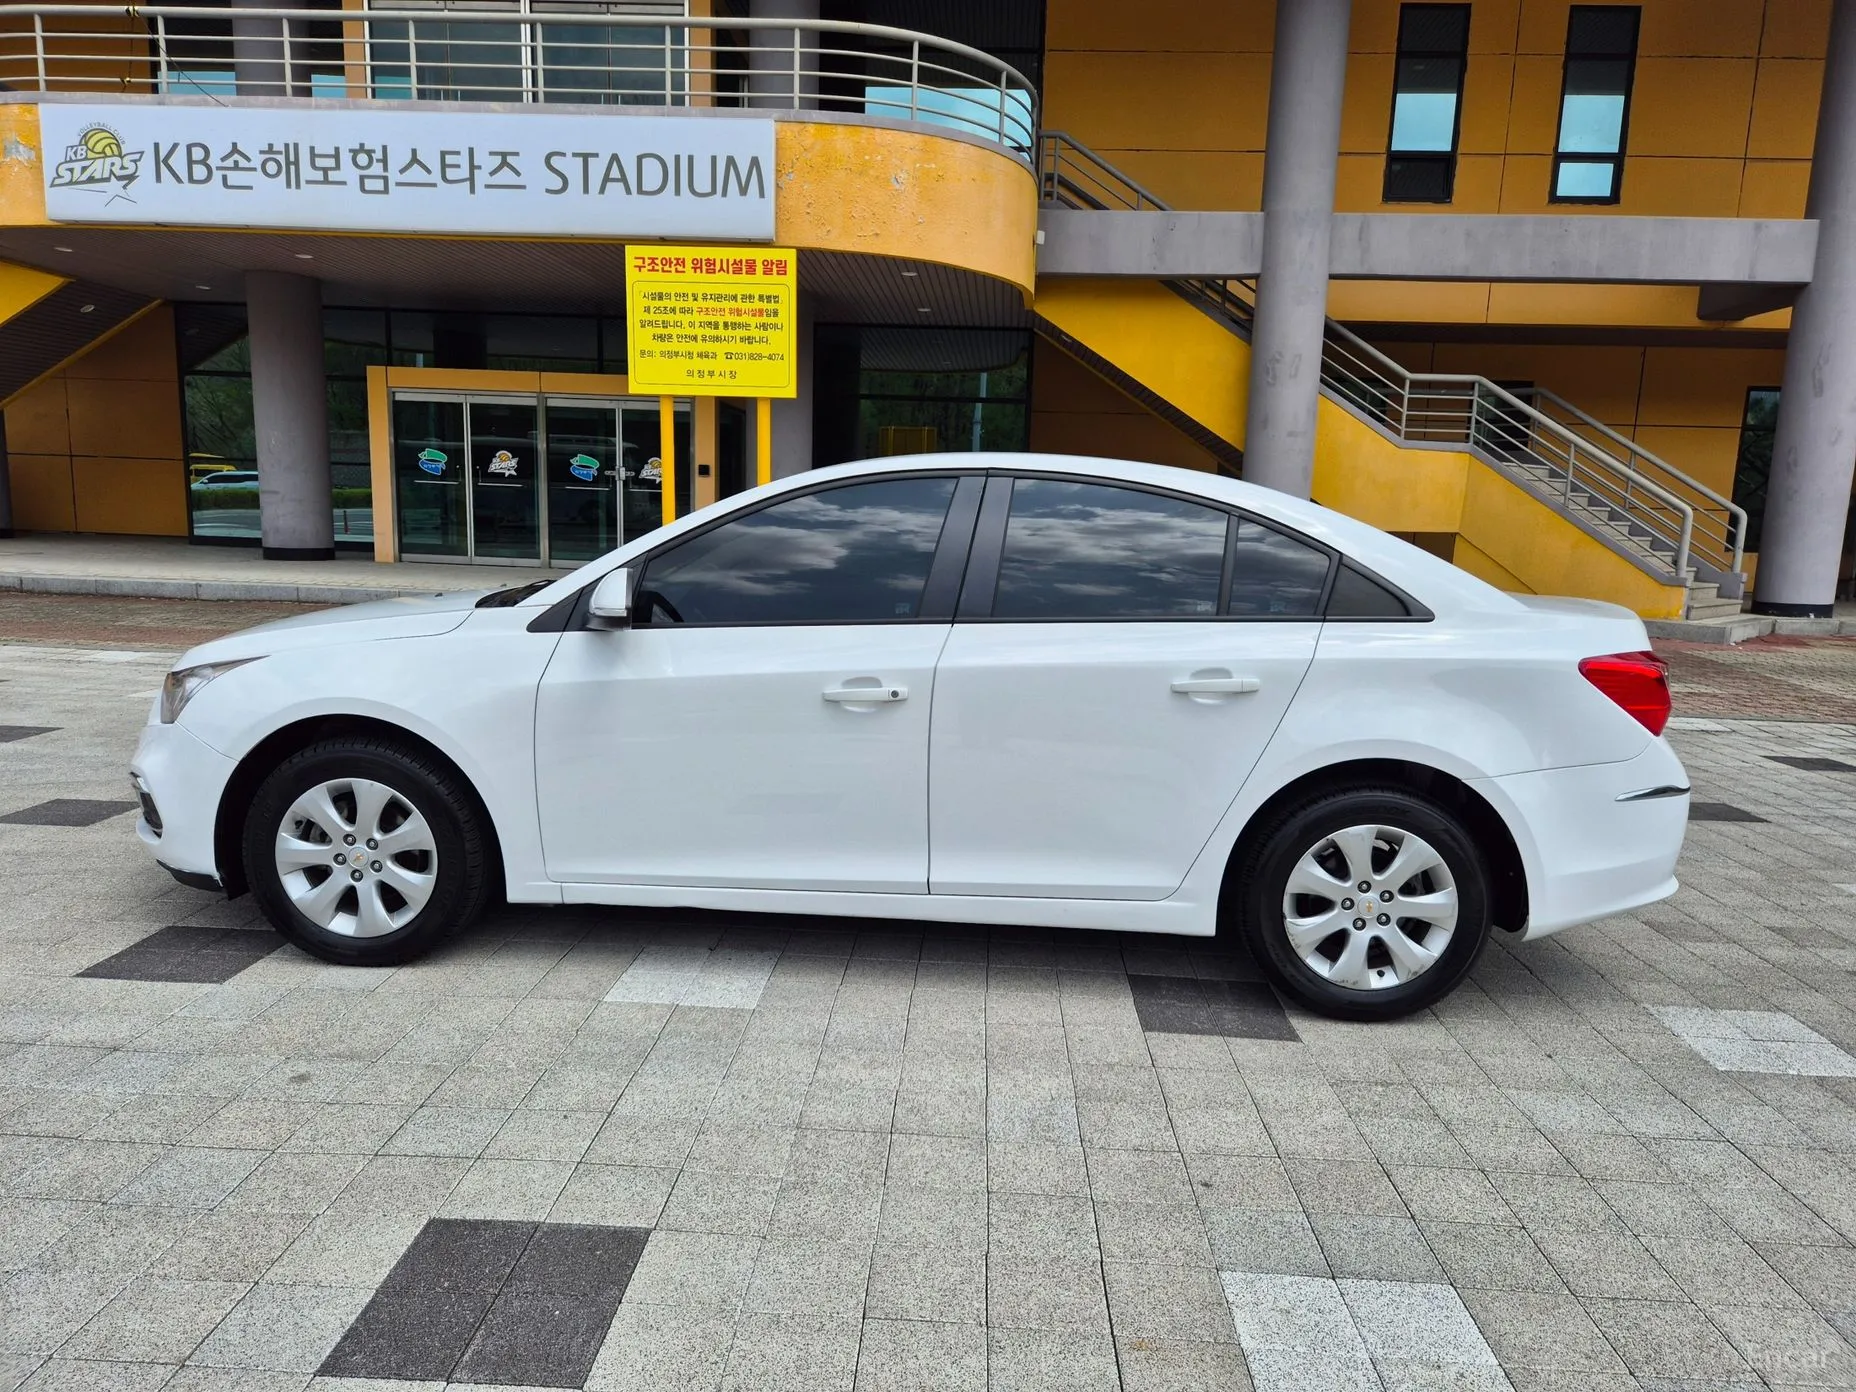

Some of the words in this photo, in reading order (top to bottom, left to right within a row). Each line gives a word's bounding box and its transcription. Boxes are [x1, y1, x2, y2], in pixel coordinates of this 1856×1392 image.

[65, 145, 87, 161] KB
[49, 151, 145, 188] STARS
[153, 141, 527, 195] KB손해보험스타즈
[544, 151, 765, 199] STADIUM
[633, 256, 686, 273] 구조안전
[691, 257, 758, 275] 위험시설물
[762, 259, 788, 276] 알림
[674, 291, 689, 302] 안전
[691, 291, 699, 302] 및
[701, 292, 738, 303] 유지관리에
[740, 293, 755, 304] 관한
[643, 306, 651, 315] 제
[653, 306, 677, 316] 25조에
[679, 306, 694, 316] 따라
[696, 307, 726, 317] 구조안전
[688, 320, 696, 329] 이
[698, 320, 720, 331] 지역을
[754, 322, 784, 332] 사람이나
[652, 334, 674, 344] 차량은
[676, 334, 698, 344] 안전에
[700, 335, 737, 345] 유의하시기
[739, 336, 771, 346] 바랍니다.
[639, 349, 657, 359] 문의:
[659, 350, 694, 360] 의정부시청
[696, 351, 718, 360] 체육과
[488, 458, 519, 472] STARS
